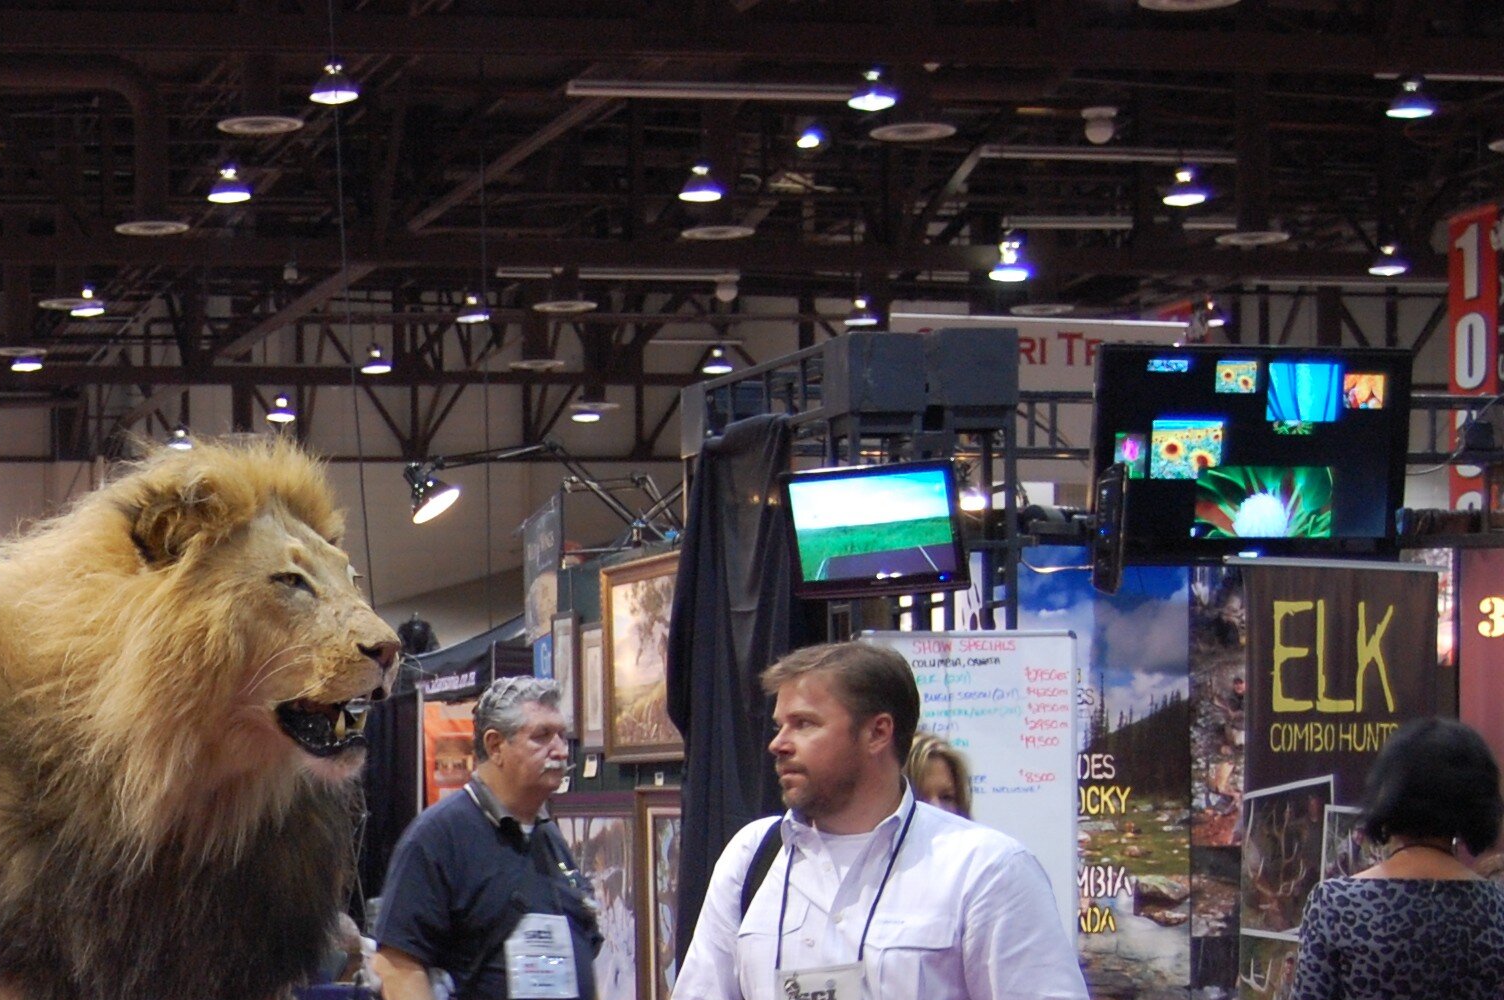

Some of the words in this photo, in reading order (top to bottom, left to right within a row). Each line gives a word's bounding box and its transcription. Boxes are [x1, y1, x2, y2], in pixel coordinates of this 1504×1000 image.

[912, 640, 952, 654] SHOW
[959, 640, 1016, 652] SPECIALS
[1270, 600, 1394, 713] ELK
[1270, 723, 1335, 752] COMBO
